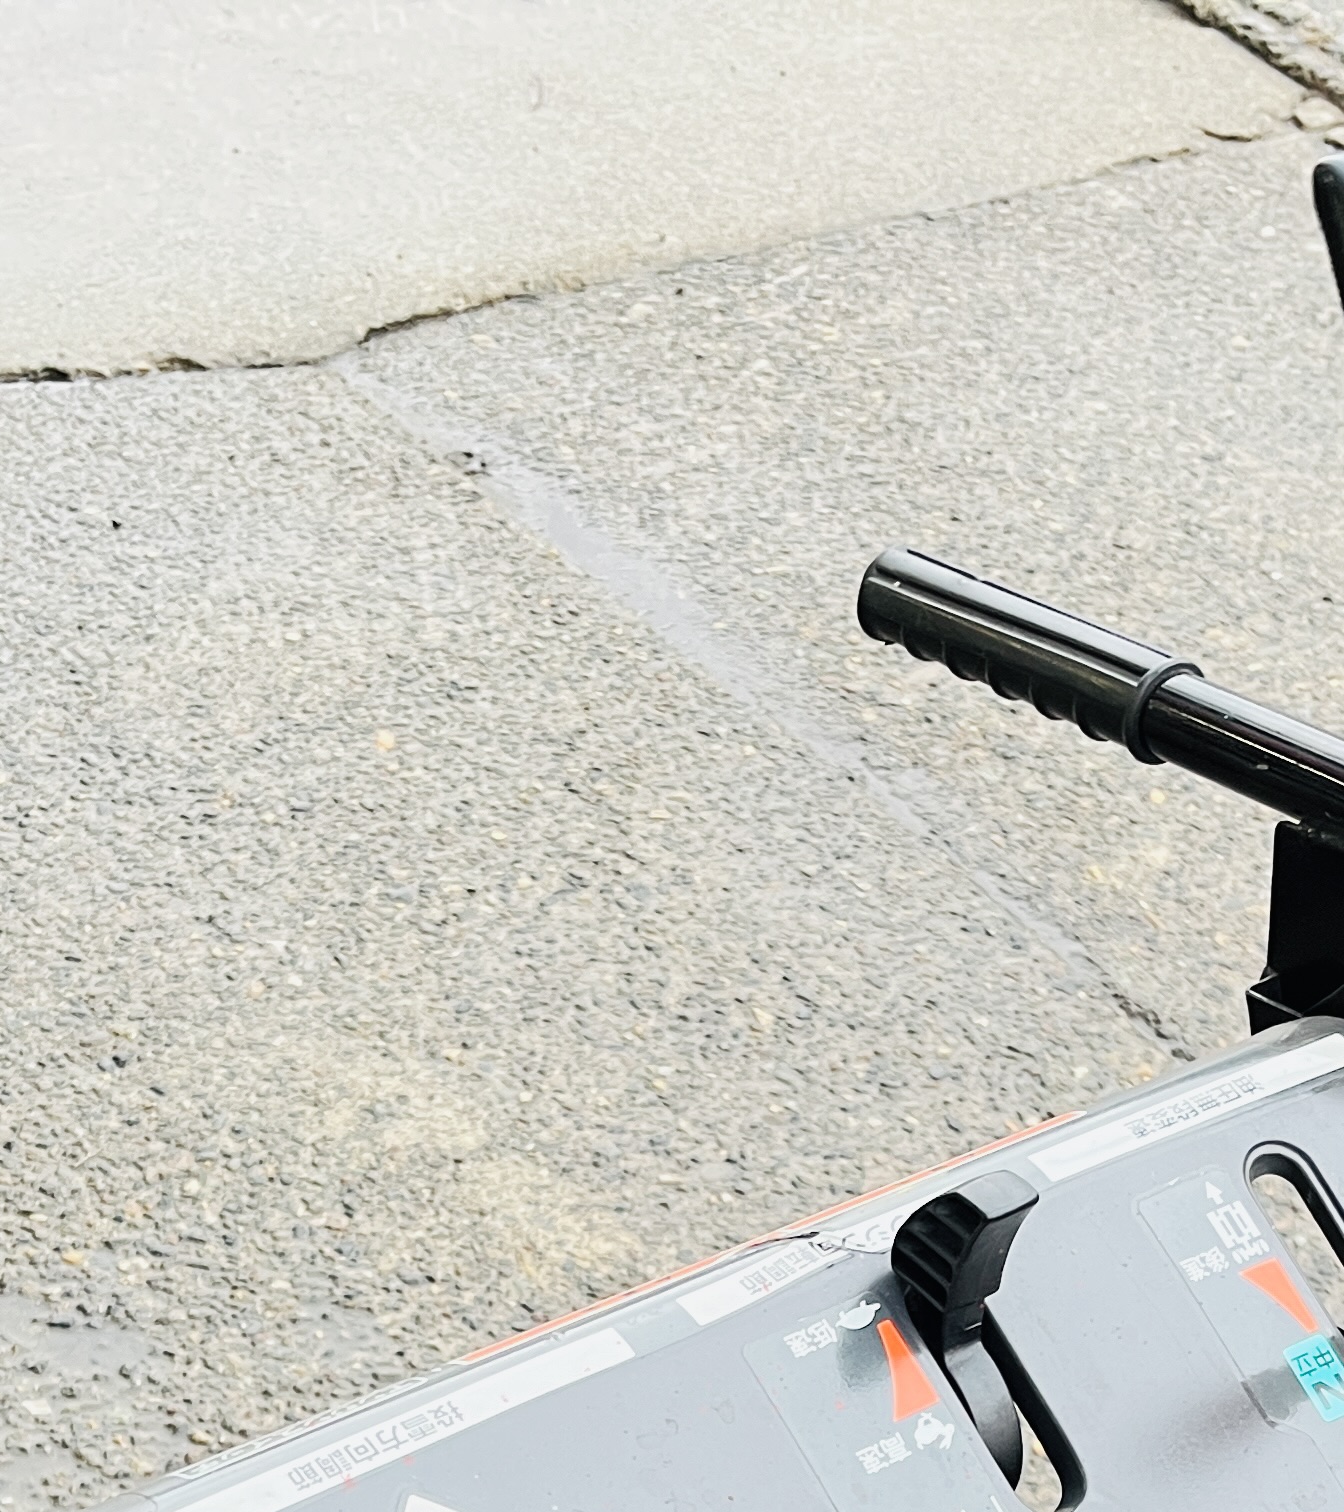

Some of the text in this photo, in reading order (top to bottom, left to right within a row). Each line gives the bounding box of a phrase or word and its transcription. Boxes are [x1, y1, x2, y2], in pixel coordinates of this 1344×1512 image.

[1179, 1245, 1230, 1282] 後進
[783, 1318, 838, 1358] 低速
[1291, 1346, 1335, 1377] 中立
[287, 1400, 465, 1491] 投雪方向調節
[855, 1431, 913, 1475] 高速
